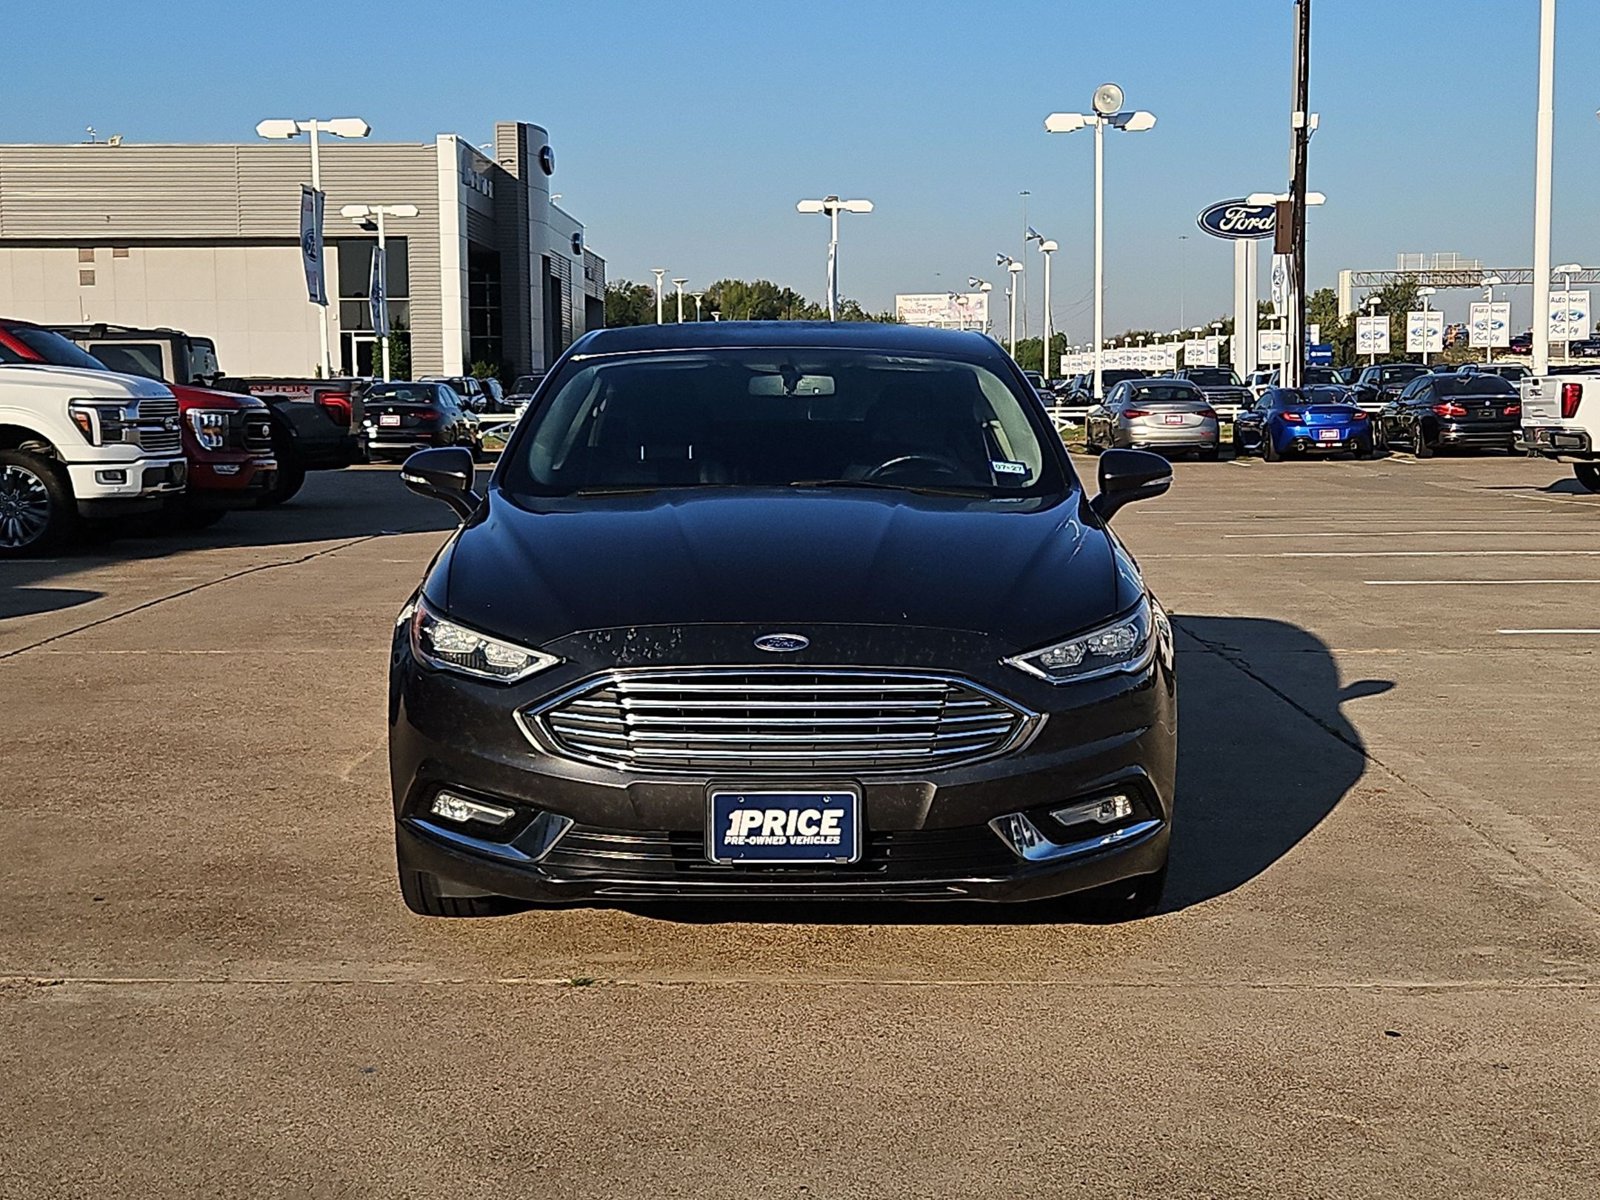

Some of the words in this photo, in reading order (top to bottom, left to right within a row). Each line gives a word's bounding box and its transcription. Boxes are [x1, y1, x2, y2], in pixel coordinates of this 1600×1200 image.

[1219, 206, 1275, 230] Ford
[249, 385, 309, 395] APTOR
[726, 809, 844, 836] 1PRICE
[724, 836, 787, 845] PRE-OWNED
[789, 836, 840, 845] VEHICLES
